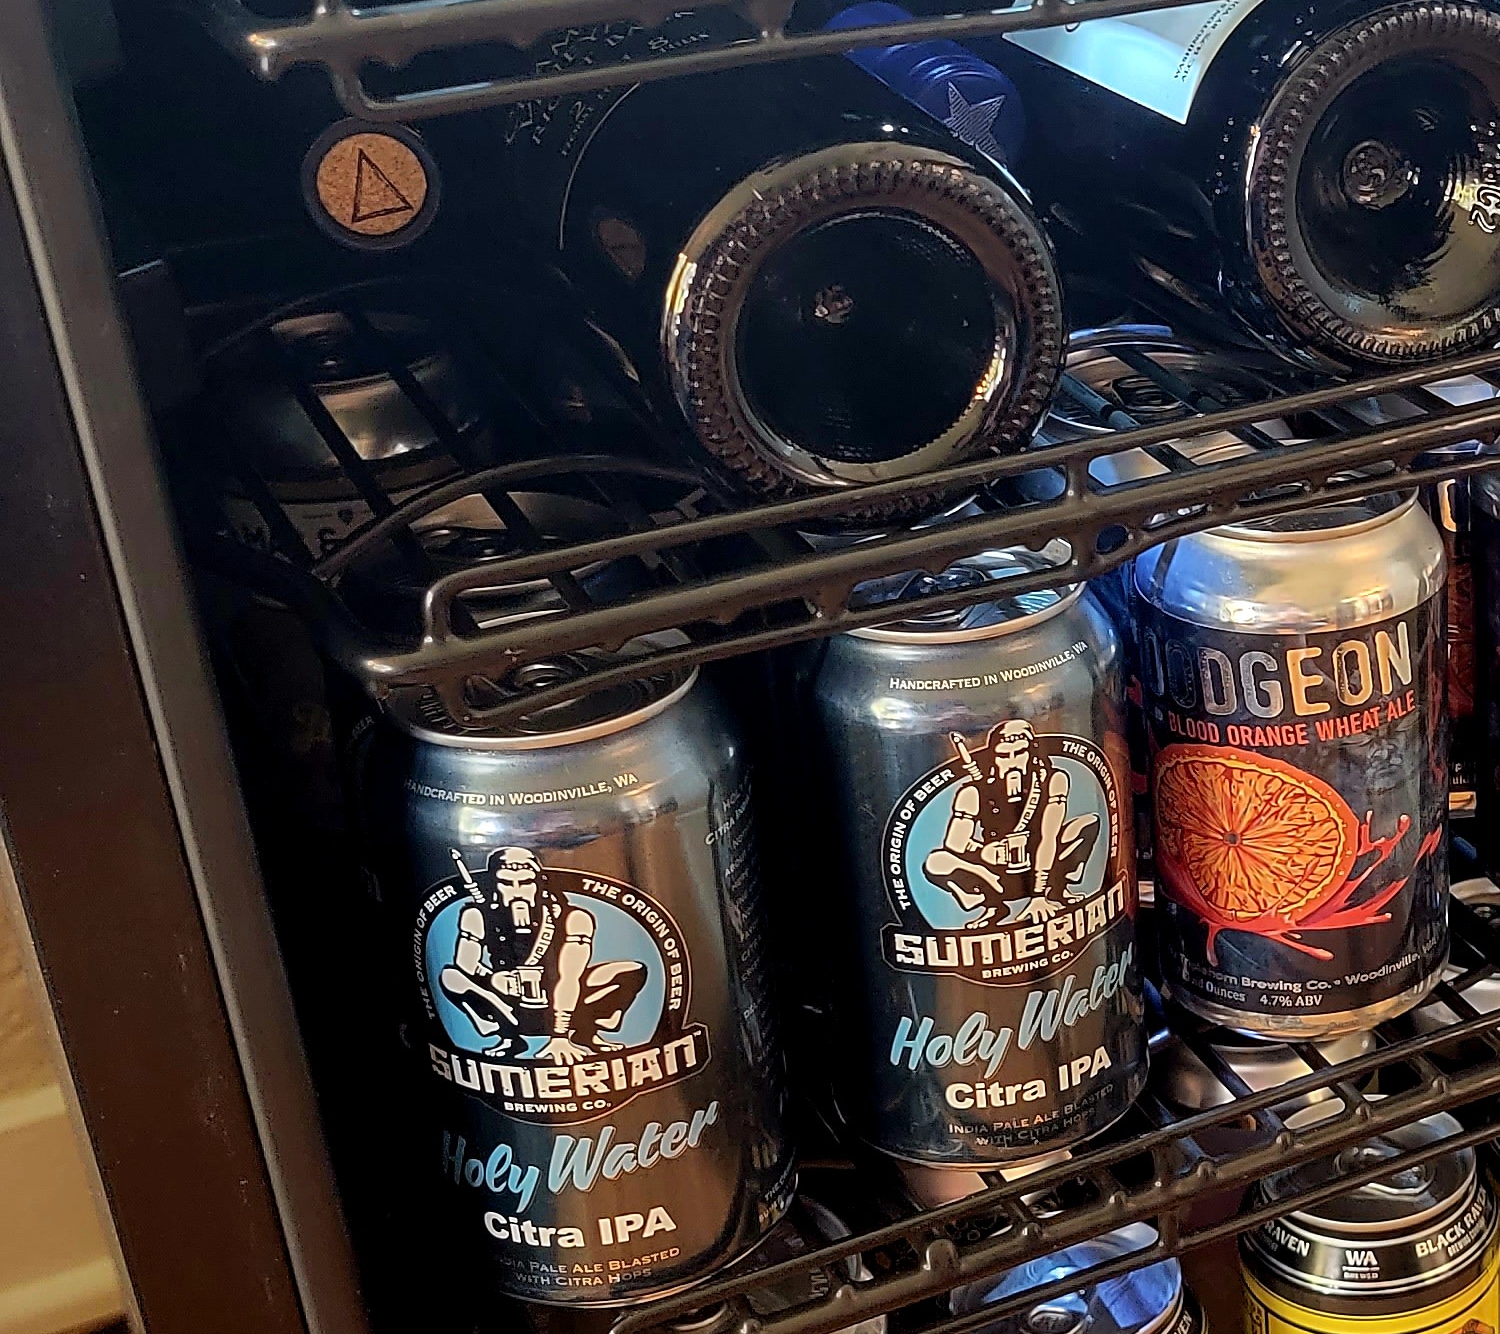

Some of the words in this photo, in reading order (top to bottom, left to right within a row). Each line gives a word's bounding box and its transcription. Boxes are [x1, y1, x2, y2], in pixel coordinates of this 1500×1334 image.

[890, 677, 980, 690] HANDCRAFTED
[984, 675, 998, 686] IN
[1072, 640, 1088, 655] WA
[1168, 710, 1220, 743] BLOOD
[1227, 723, 1309, 747] ORANGE
[1315, 707, 1380, 742] WHEAT
[1387, 689, 1416, 723] ALE
[404, 779, 486, 806] HANDCRAFTED
[489, 793, 504, 806] IN
[614, 773, 638, 787] WA
[916, 768, 955, 800] BEER
[1062, 741, 1085, 757] THE
[1086, 751, 1113, 788] ORIGIN
[1108, 787, 1117, 808] OF
[901, 800, 916, 820] OF
[890, 822, 906, 874] ORIGIN
[417, 910, 428, 929] OF
[423, 884, 457, 914] BEER
[582, 879, 621, 899] THE
[891, 881, 911, 910] THE
[622, 893, 670, 939] ORIGIN
[894, 880, 1126, 966] SUMERIAN
[663, 937, 680, 961] OF
[982, 959, 1048, 978] BREWING
[1052, 951, 1073, 964] CO.
[669, 962, 684, 1011] BEER
[1242, 978, 1302, 993] Brewing
[1306, 979, 1332, 991] Co.
[1344, 953, 1420, 986] Woodinville,
[891, 1012, 1014, 1079] Holy
[1018, 942, 1133, 1050] Water
[1260, 994, 1292, 1007] 4.7%
[1295, 995, 1322, 1006] ABV
[429, 1034, 697, 1099] SUMERIAN
[946, 1079, 1046, 1109] Citra
[1058, 1046, 1112, 1091] IPA
[504, 1101, 577, 1113] BREWING
[582, 1099, 612, 1110] CO.
[949, 1123, 989, 1134] INDIA
[993, 1120, 1029, 1132] PALE
[1033, 1111, 1059, 1125] ALE
[443, 1131, 540, 1213] Holy
[548, 1100, 720, 1194] Water
[484, 1211, 585, 1248] Citra
[598, 1206, 677, 1246] IPA
[1415, 1222, 1465, 1258] BLACK
[529, 1261, 568, 1274] PALE
[572, 1262, 604, 1274] ALE
[608, 1247, 680, 1272] BLASTED
[1345, 1250, 1378, 1266] WA
[514, 1272, 550, 1285] WITH
[555, 1275, 603, 1287] CITRA
[607, 1268, 653, 1283] HOPS
